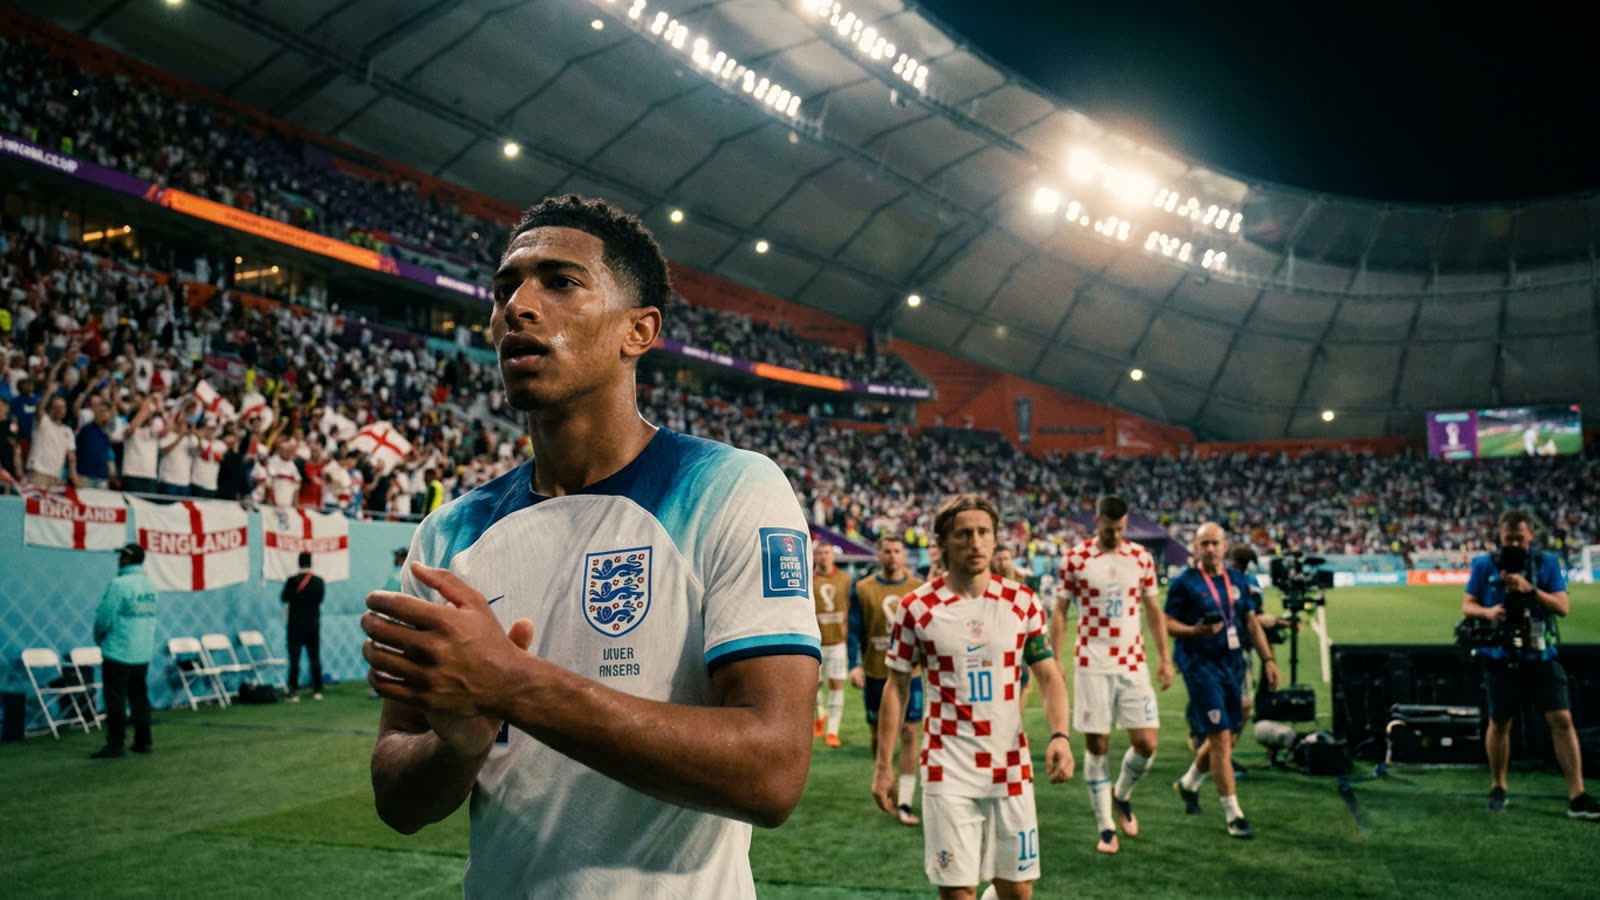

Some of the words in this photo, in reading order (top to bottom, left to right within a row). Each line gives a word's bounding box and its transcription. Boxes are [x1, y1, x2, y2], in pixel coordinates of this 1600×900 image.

[40, 499, 118, 522] ENGLAND
[147, 528, 242, 555] ENGLAND
[967, 671, 993, 702] 10
